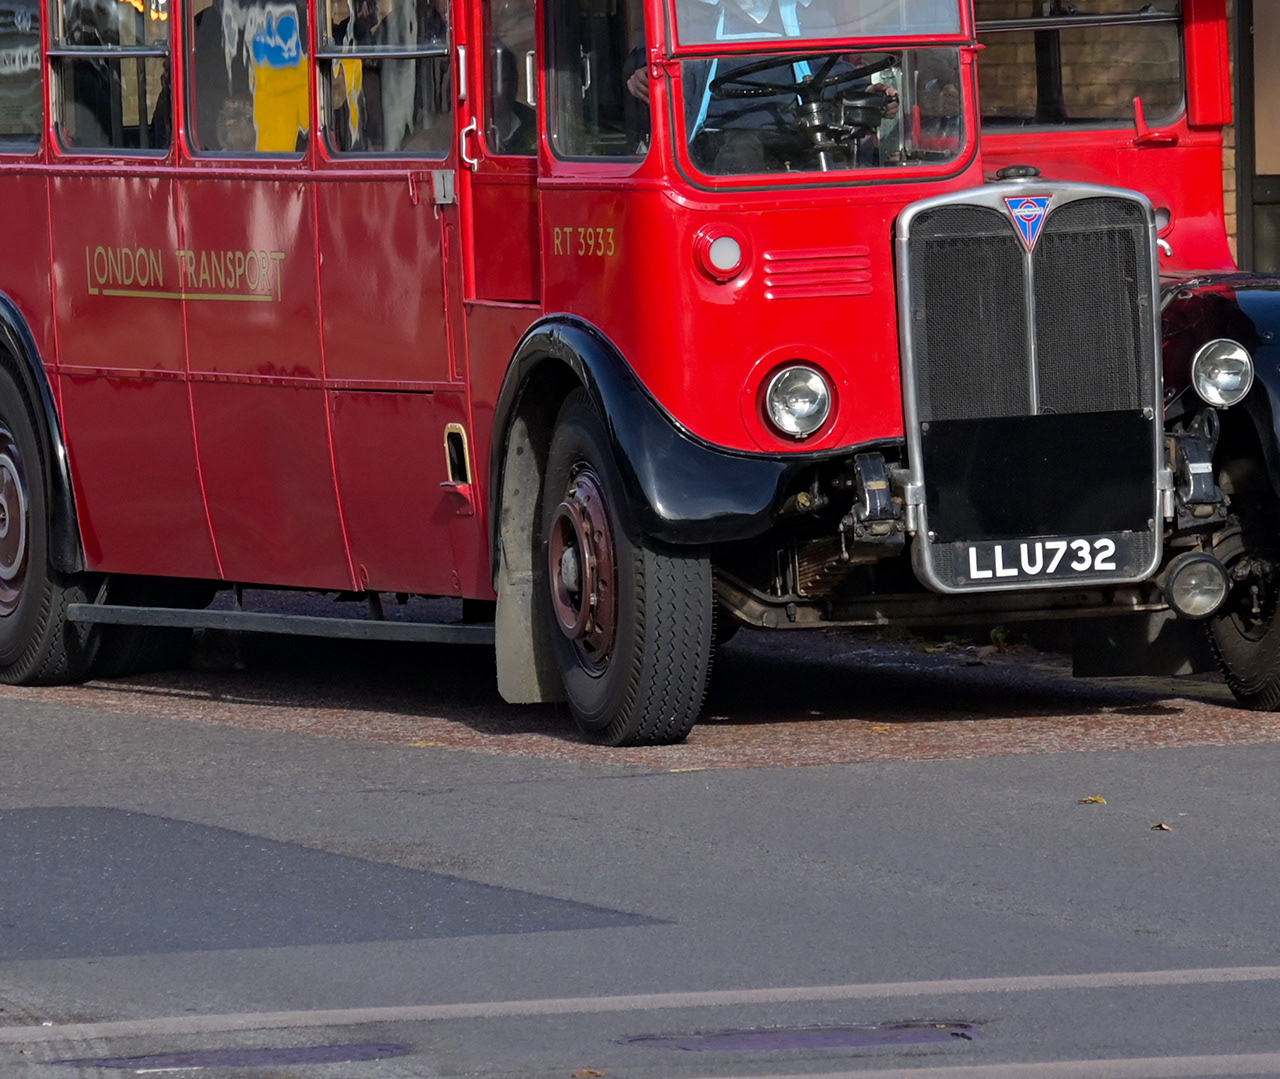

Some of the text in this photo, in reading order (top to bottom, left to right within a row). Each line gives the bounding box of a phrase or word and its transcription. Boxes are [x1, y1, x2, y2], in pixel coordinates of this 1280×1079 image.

[554, 227, 615, 256] RT 3933
[86, 246, 286, 302] LONDON TRANSPORT
[969, 538, 1116, 579] LLU732
